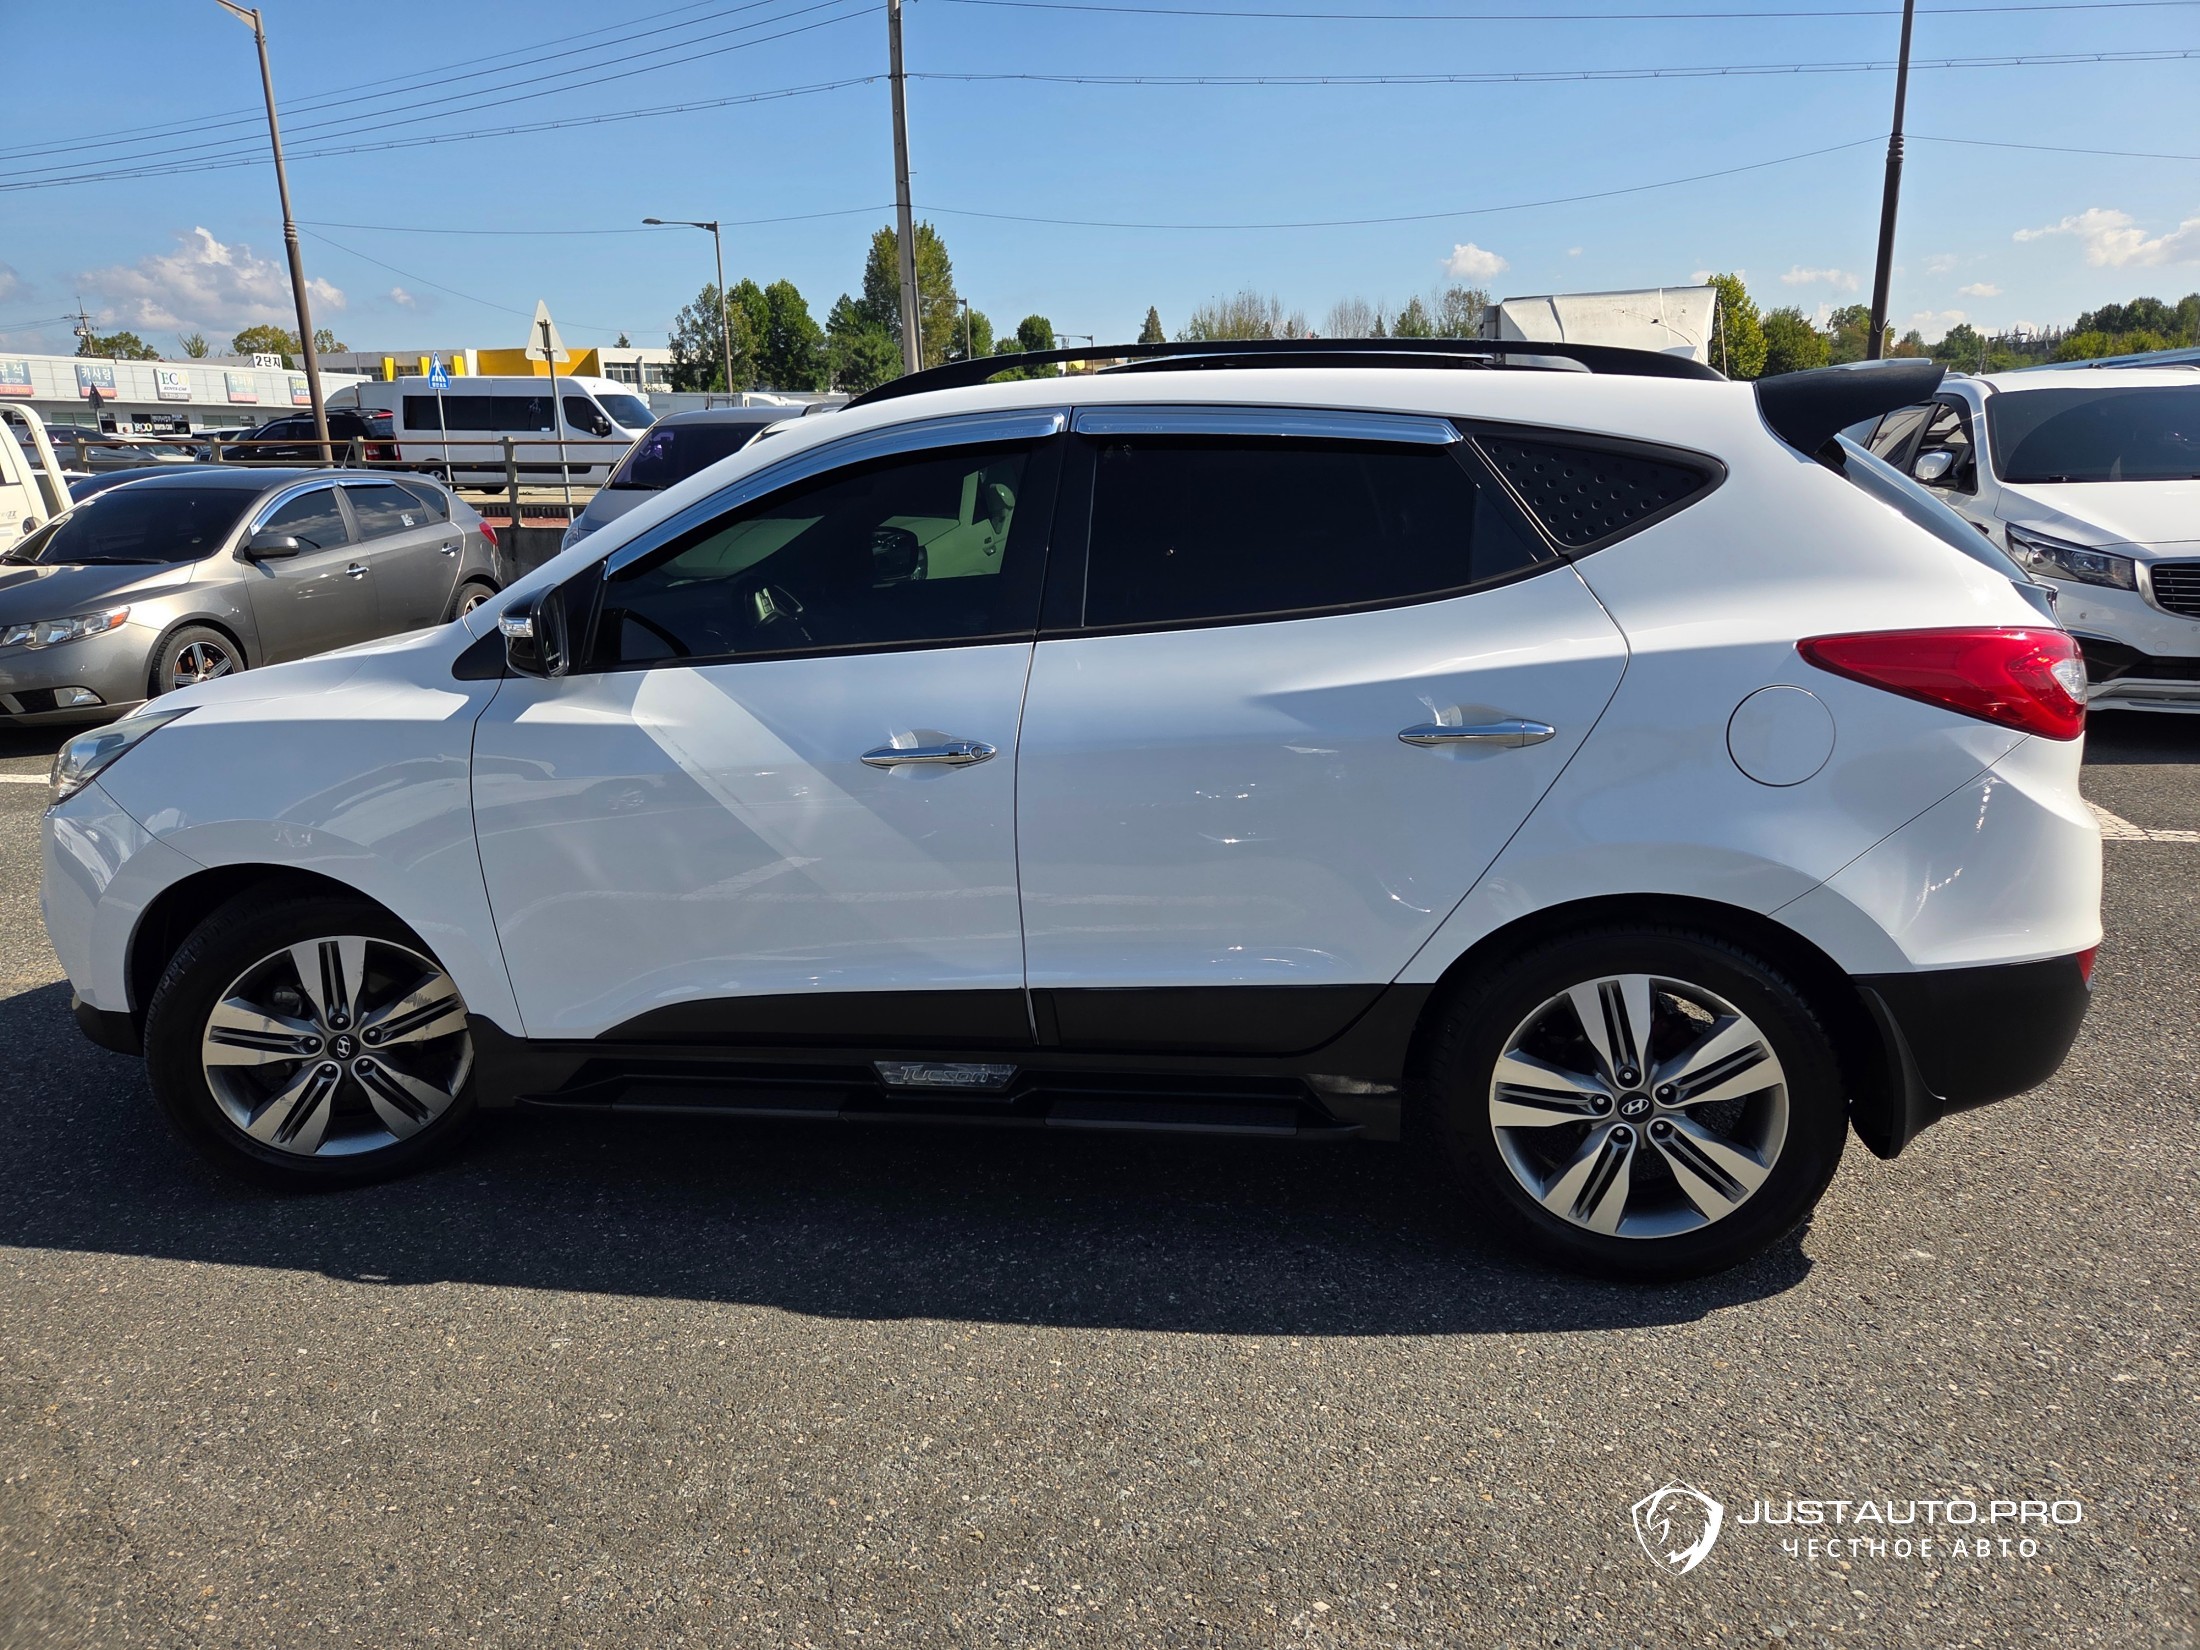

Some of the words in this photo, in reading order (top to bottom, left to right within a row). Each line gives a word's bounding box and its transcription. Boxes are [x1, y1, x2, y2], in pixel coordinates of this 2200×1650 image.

[255, 355, 281, 369] 2단지
[81, 367, 111, 380] 카사랑
[161, 372, 188, 385] ECO
[901, 1064, 988, 1082] Tucson
